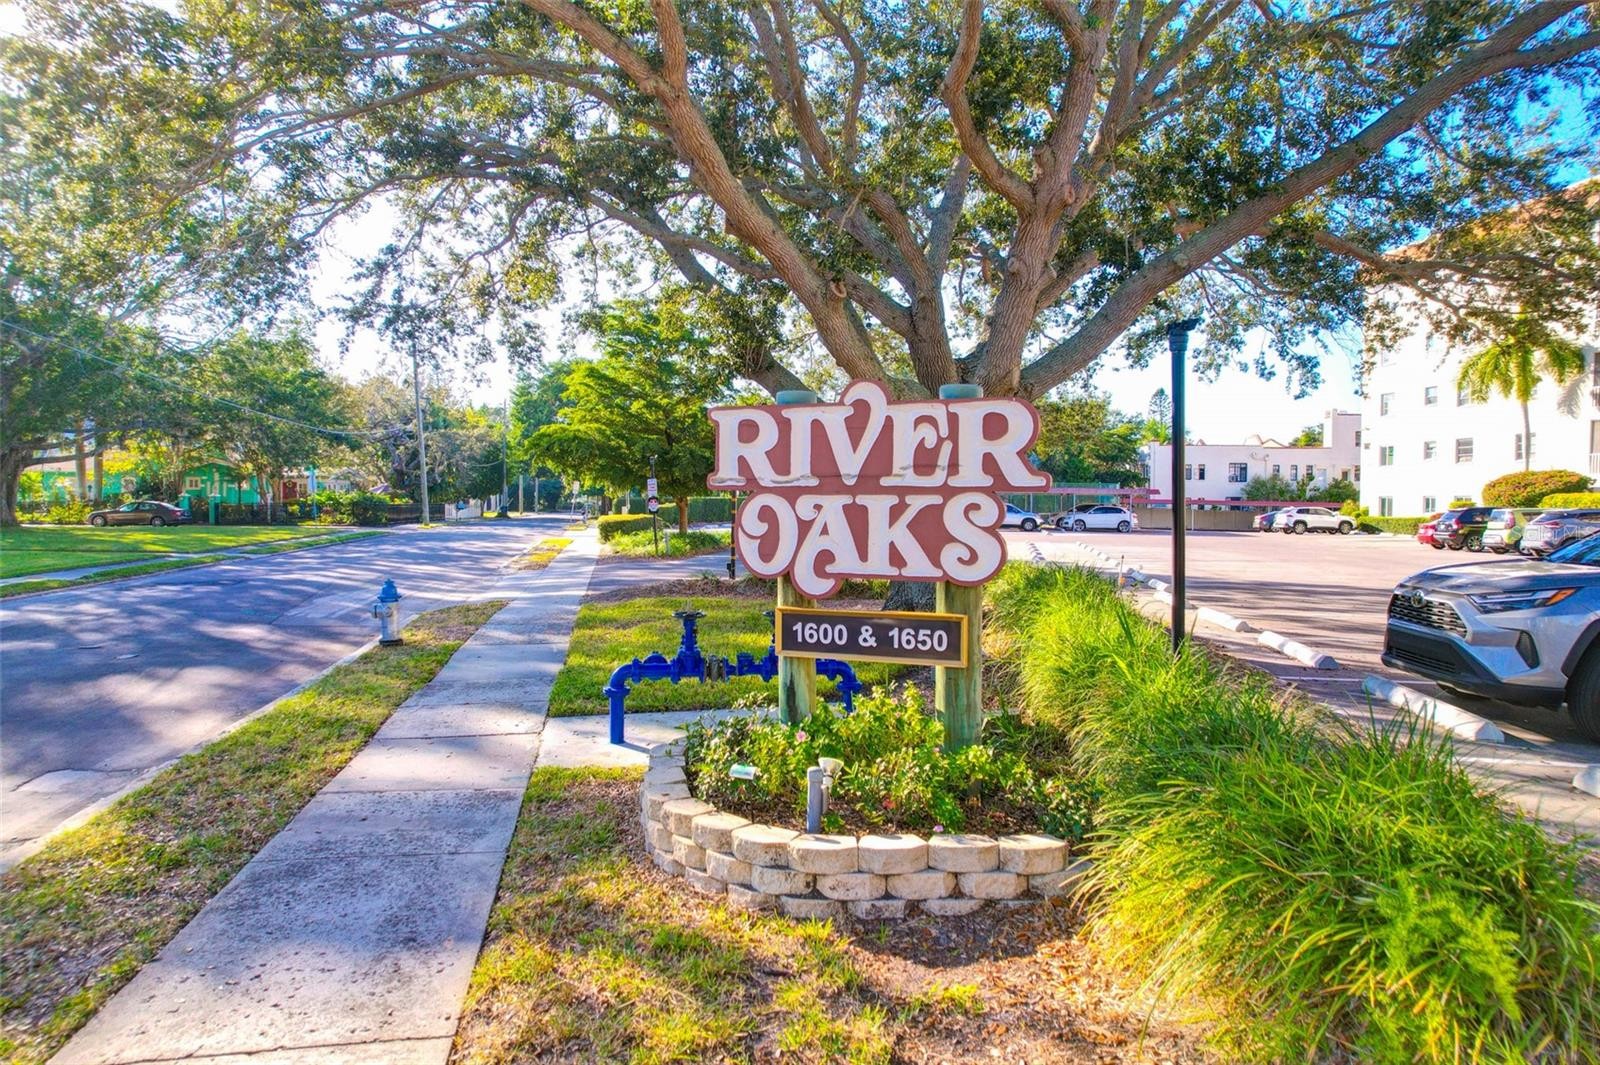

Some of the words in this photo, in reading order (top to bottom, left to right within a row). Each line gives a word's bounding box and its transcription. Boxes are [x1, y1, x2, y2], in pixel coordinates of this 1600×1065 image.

[710, 382, 1047, 487] RIVER
[737, 493, 1002, 595] OAKS
[792, 622, 848, 646] 1600
[857, 625, 878, 648] &
[888, 627, 948, 651] 1650
